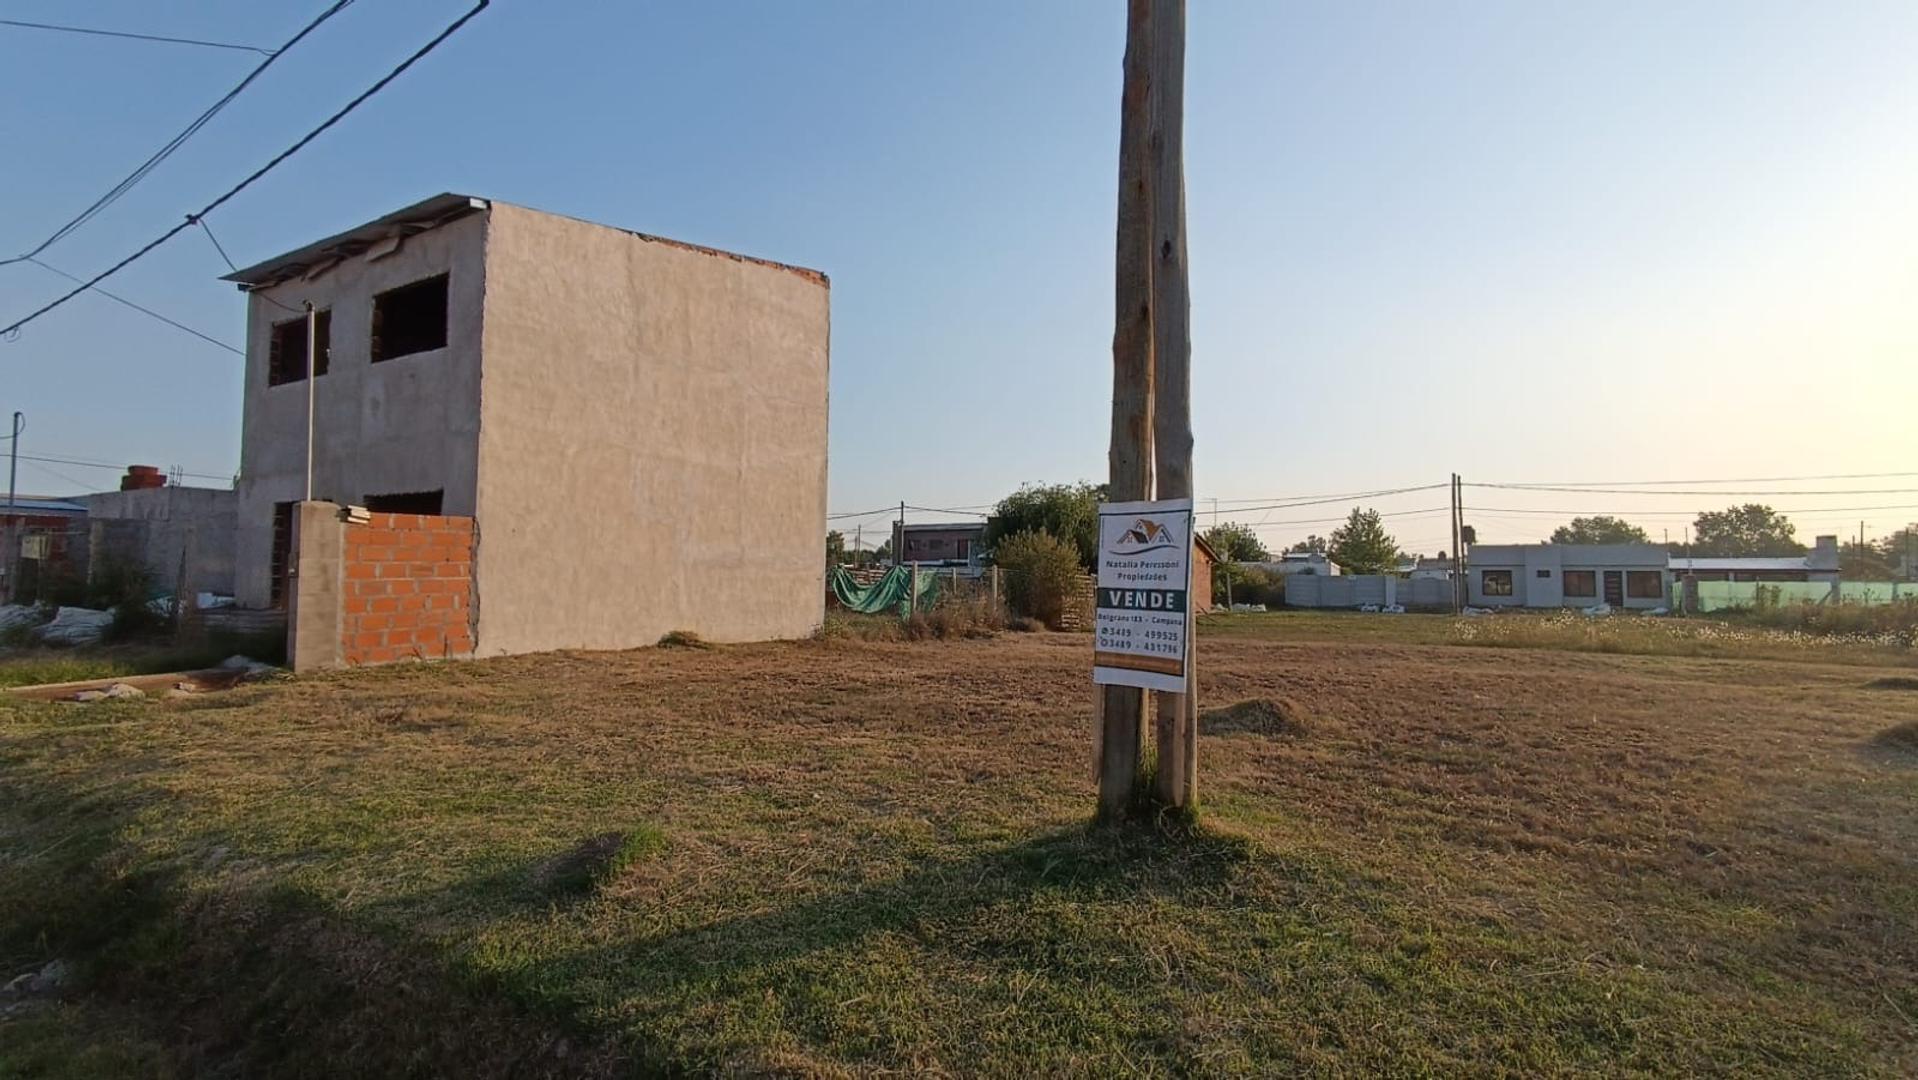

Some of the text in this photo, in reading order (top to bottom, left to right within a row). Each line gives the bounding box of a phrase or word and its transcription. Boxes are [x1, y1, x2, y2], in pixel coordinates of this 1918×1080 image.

[1106, 561, 1138, 569] Natalia
[1117, 573, 1167, 581] Propiedades
[1109, 590, 1175, 609] VENDE
[1098, 613, 1130, 622] Belgrano
[1152, 616, 1182, 625] Campana
